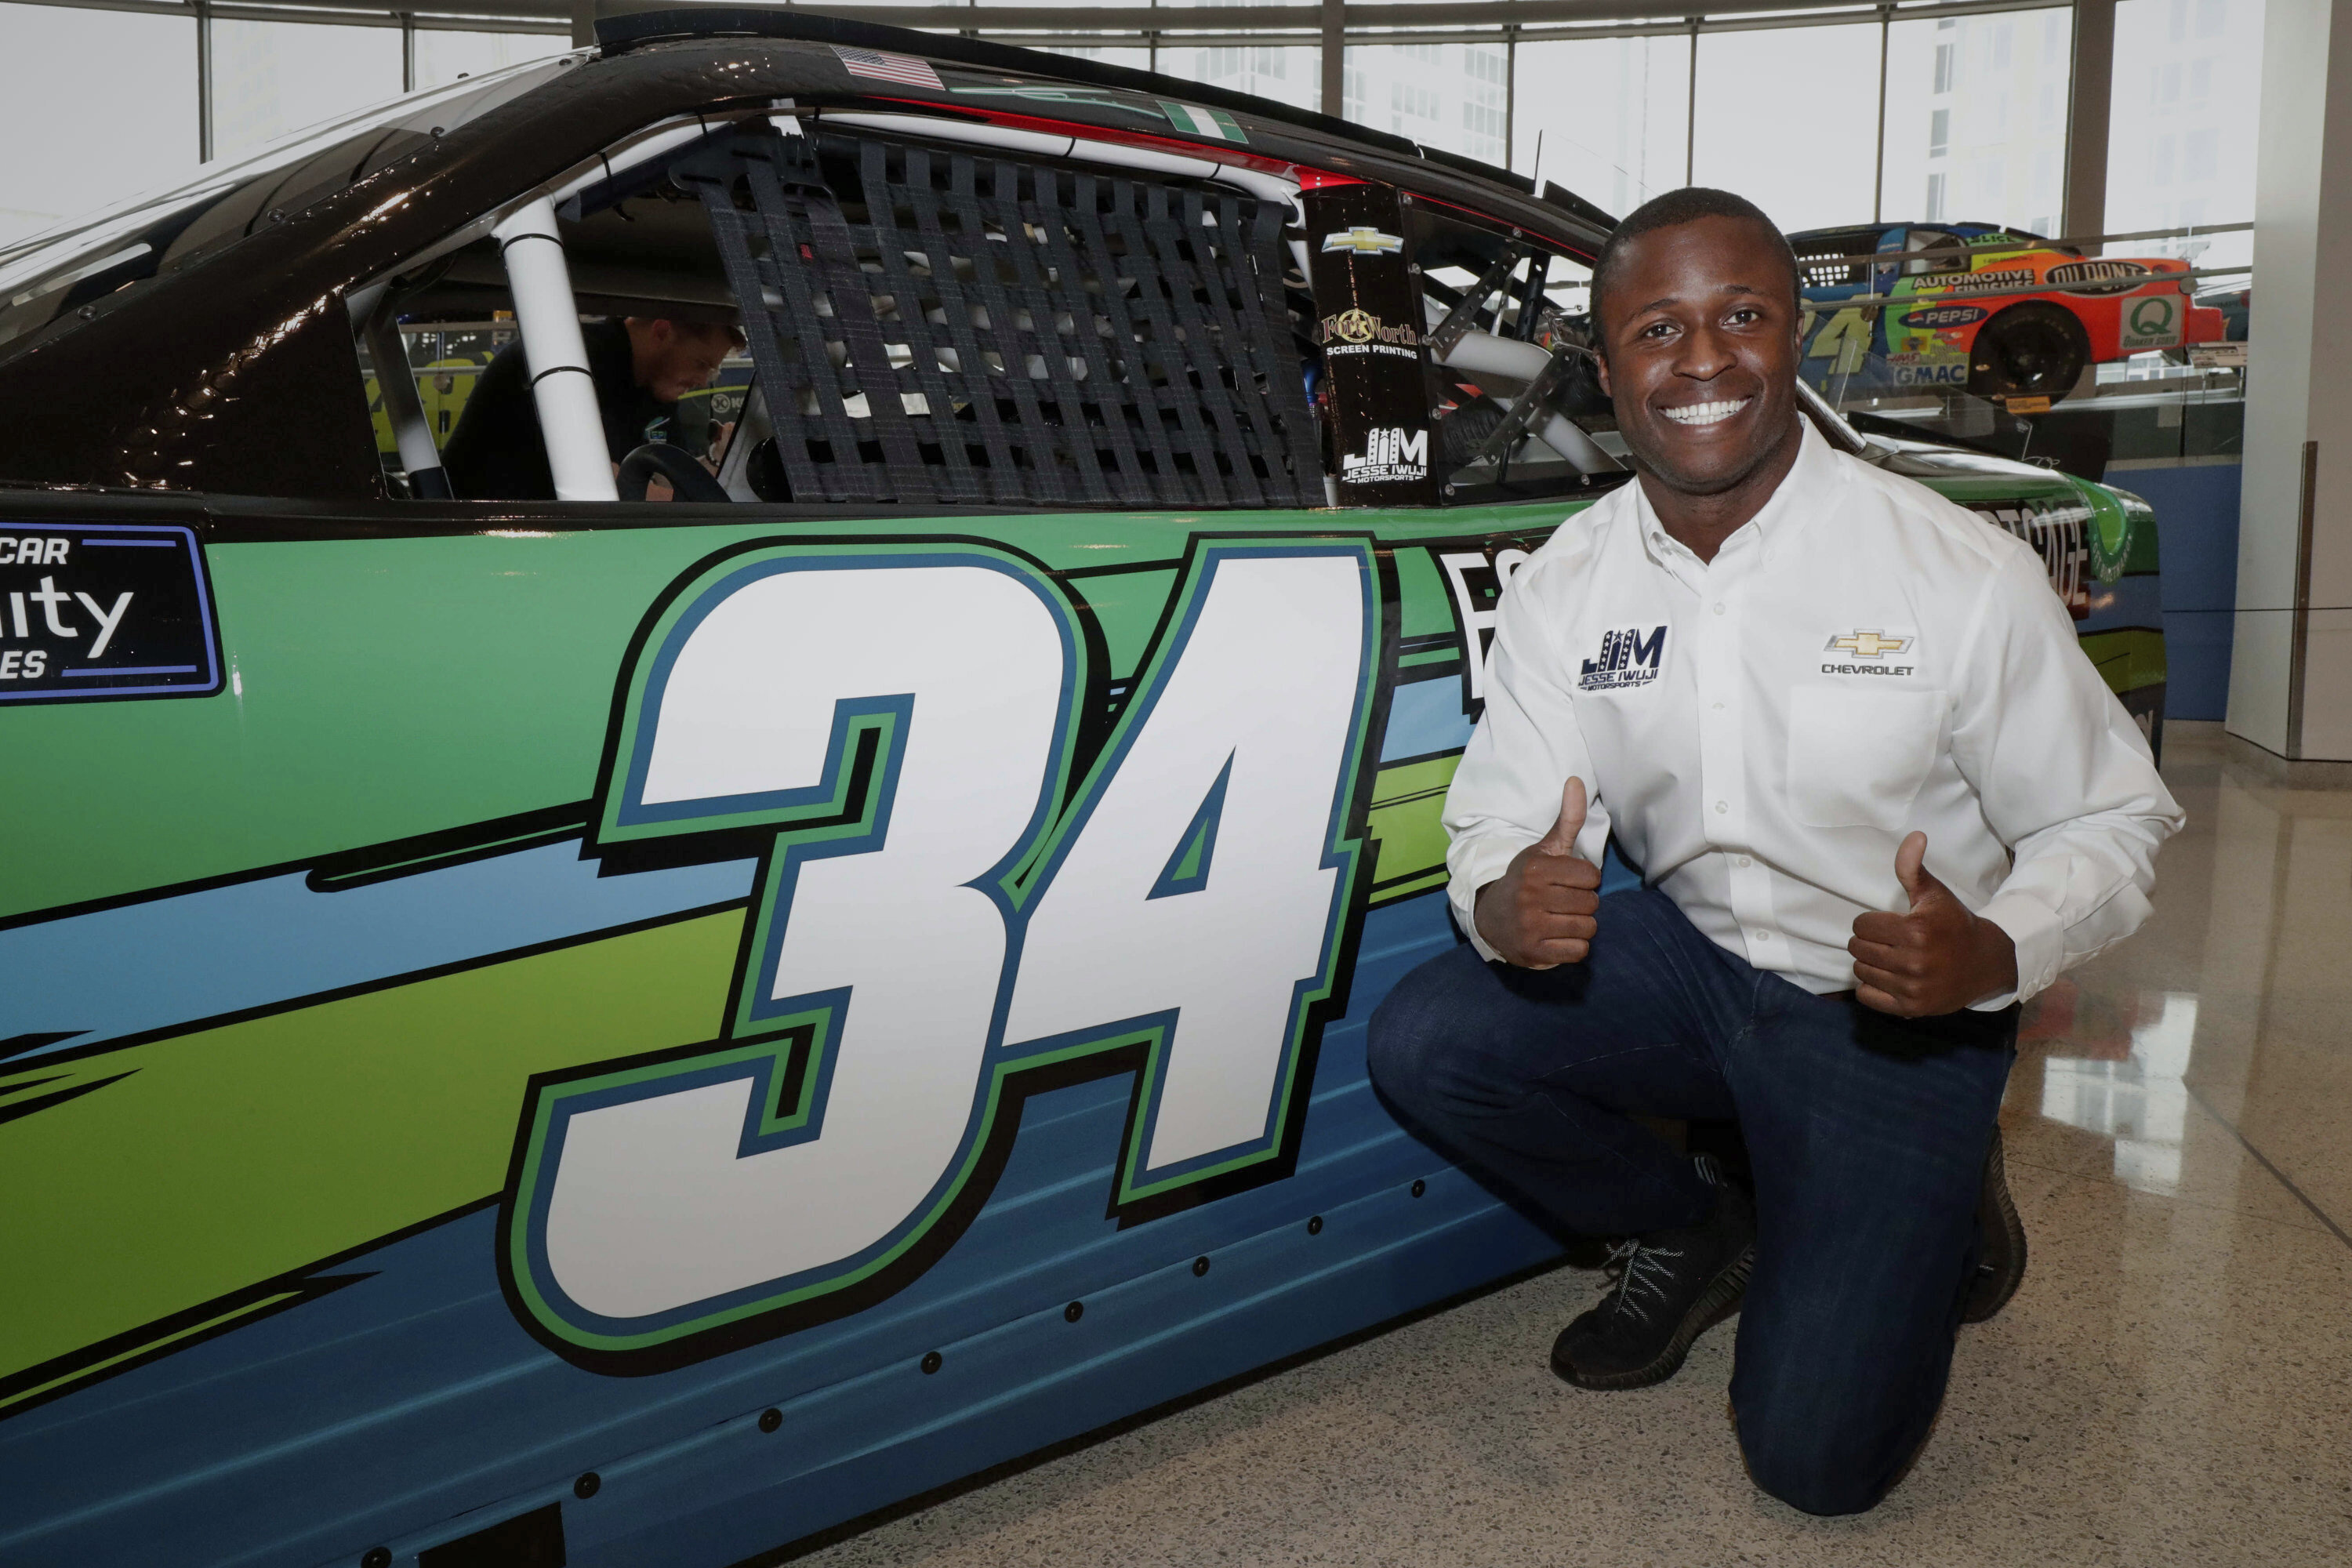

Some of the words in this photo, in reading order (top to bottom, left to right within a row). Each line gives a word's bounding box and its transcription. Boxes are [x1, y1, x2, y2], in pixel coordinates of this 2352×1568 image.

[1913, 268, 2034, 290] AUTOMOTIVE
[1925, 308, 1979, 325] PEPSI
[2129, 297, 2173, 336] Q
[1321, 314, 1364, 344] Fort
[1364, 315, 1417, 346] Worth
[1326, 344, 1370, 356] SCREEN
[1372, 344, 1417, 360] PRINTING
[1896, 365, 1965, 384] GMAC
[1342, 464, 1389, 481] JESSE
[1391, 464, 1427, 477] IWUJI
[1356, 474, 1414, 484] MOTORSPORTS
[0, 575, 134, 659] ity
[1577, 671, 1617, 687] JESSE
[1617, 668, 1659, 682] IWUJI
[1821, 663, 1914, 676] CHEVROLET
[1587, 680, 1642, 692] MOTORSPORTS
[508, 541, 1383, 1353] 34
